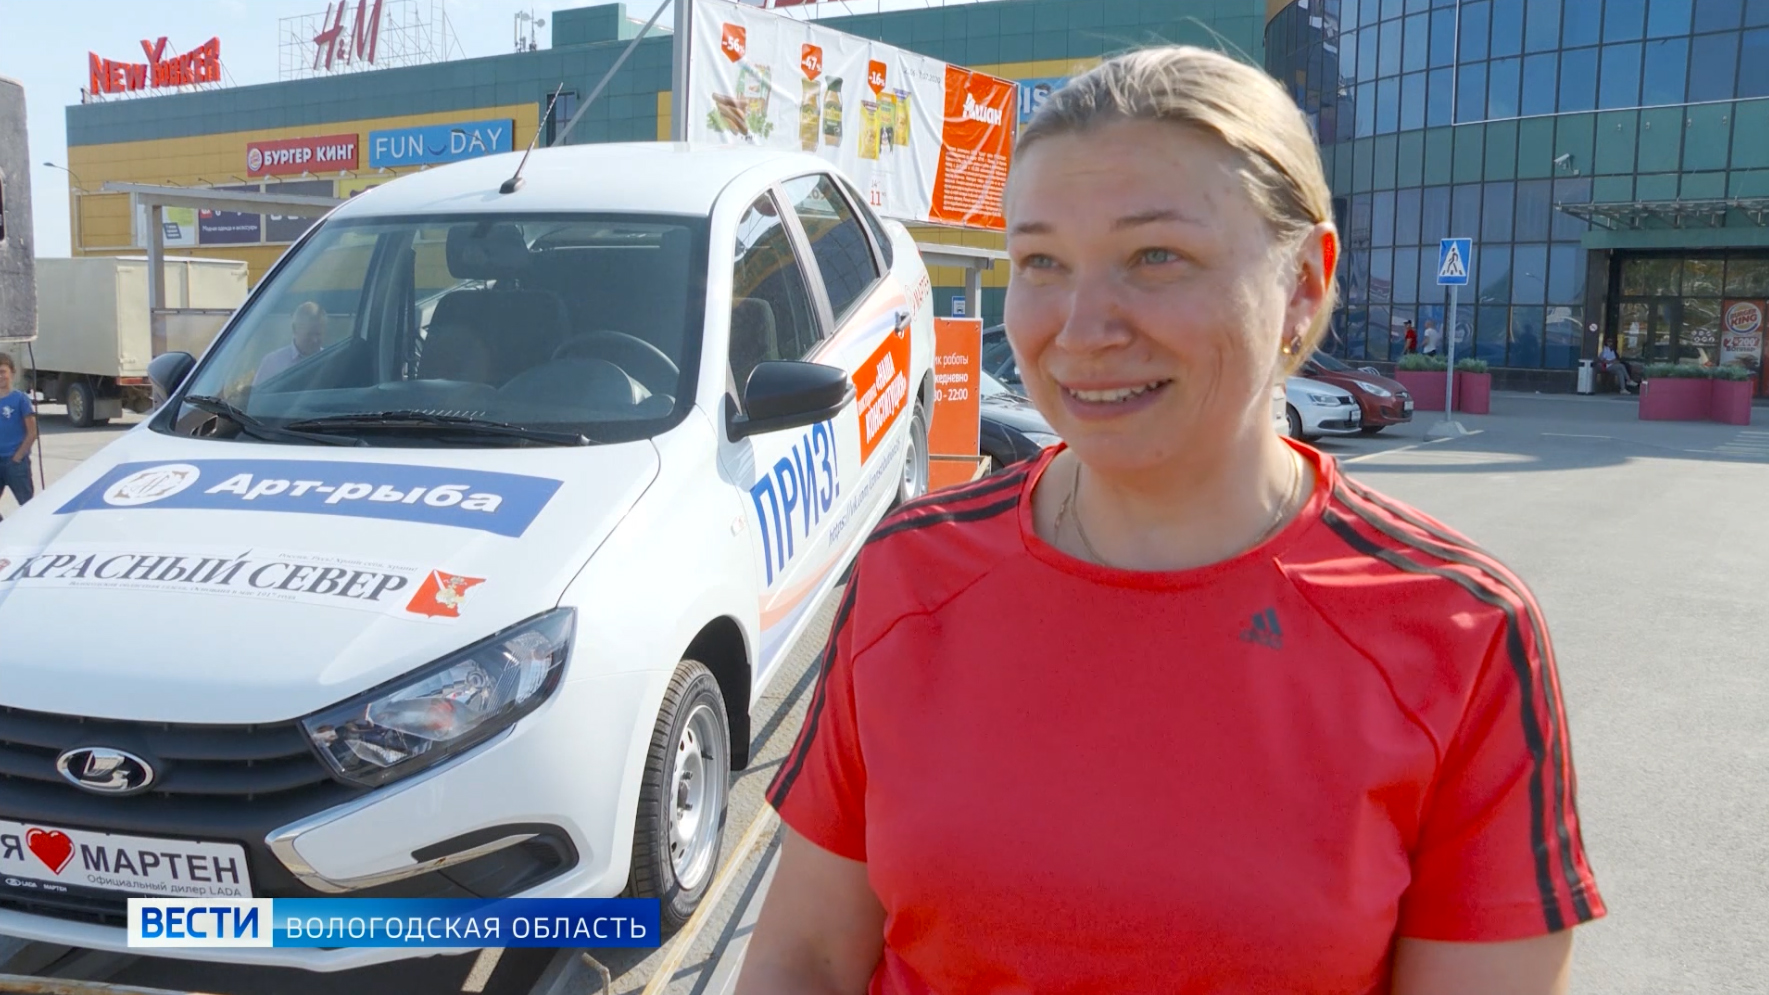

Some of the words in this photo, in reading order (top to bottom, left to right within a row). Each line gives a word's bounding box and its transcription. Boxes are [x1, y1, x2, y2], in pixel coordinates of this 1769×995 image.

[314, 0, 384, 71] H&M
[89, 51, 148, 95] NEW
[140, 36, 221, 89] YORKER
[264, 147, 312, 166] БУРГЕР
[316, 144, 355, 162] КИНГ
[376, 135, 424, 159] FUN
[451, 127, 503, 154] DAY
[1731, 314, 1758, 327] KING
[948, 388, 969, 401] 22:00
[205, 473, 503, 513] Арт-рыба
[750, 419, 840, 588] ПРИЗ!
[1, 548, 253, 585] КРАСНЫЙ
[248, 562, 409, 601] СЕВЕР
[1, 833, 25, 861] Я
[80, 843, 240, 884] МАРТЕН
[87, 874, 167, 892] Официальный
[170, 884, 207, 896] дилер
[209, 887, 242, 897] LADA
